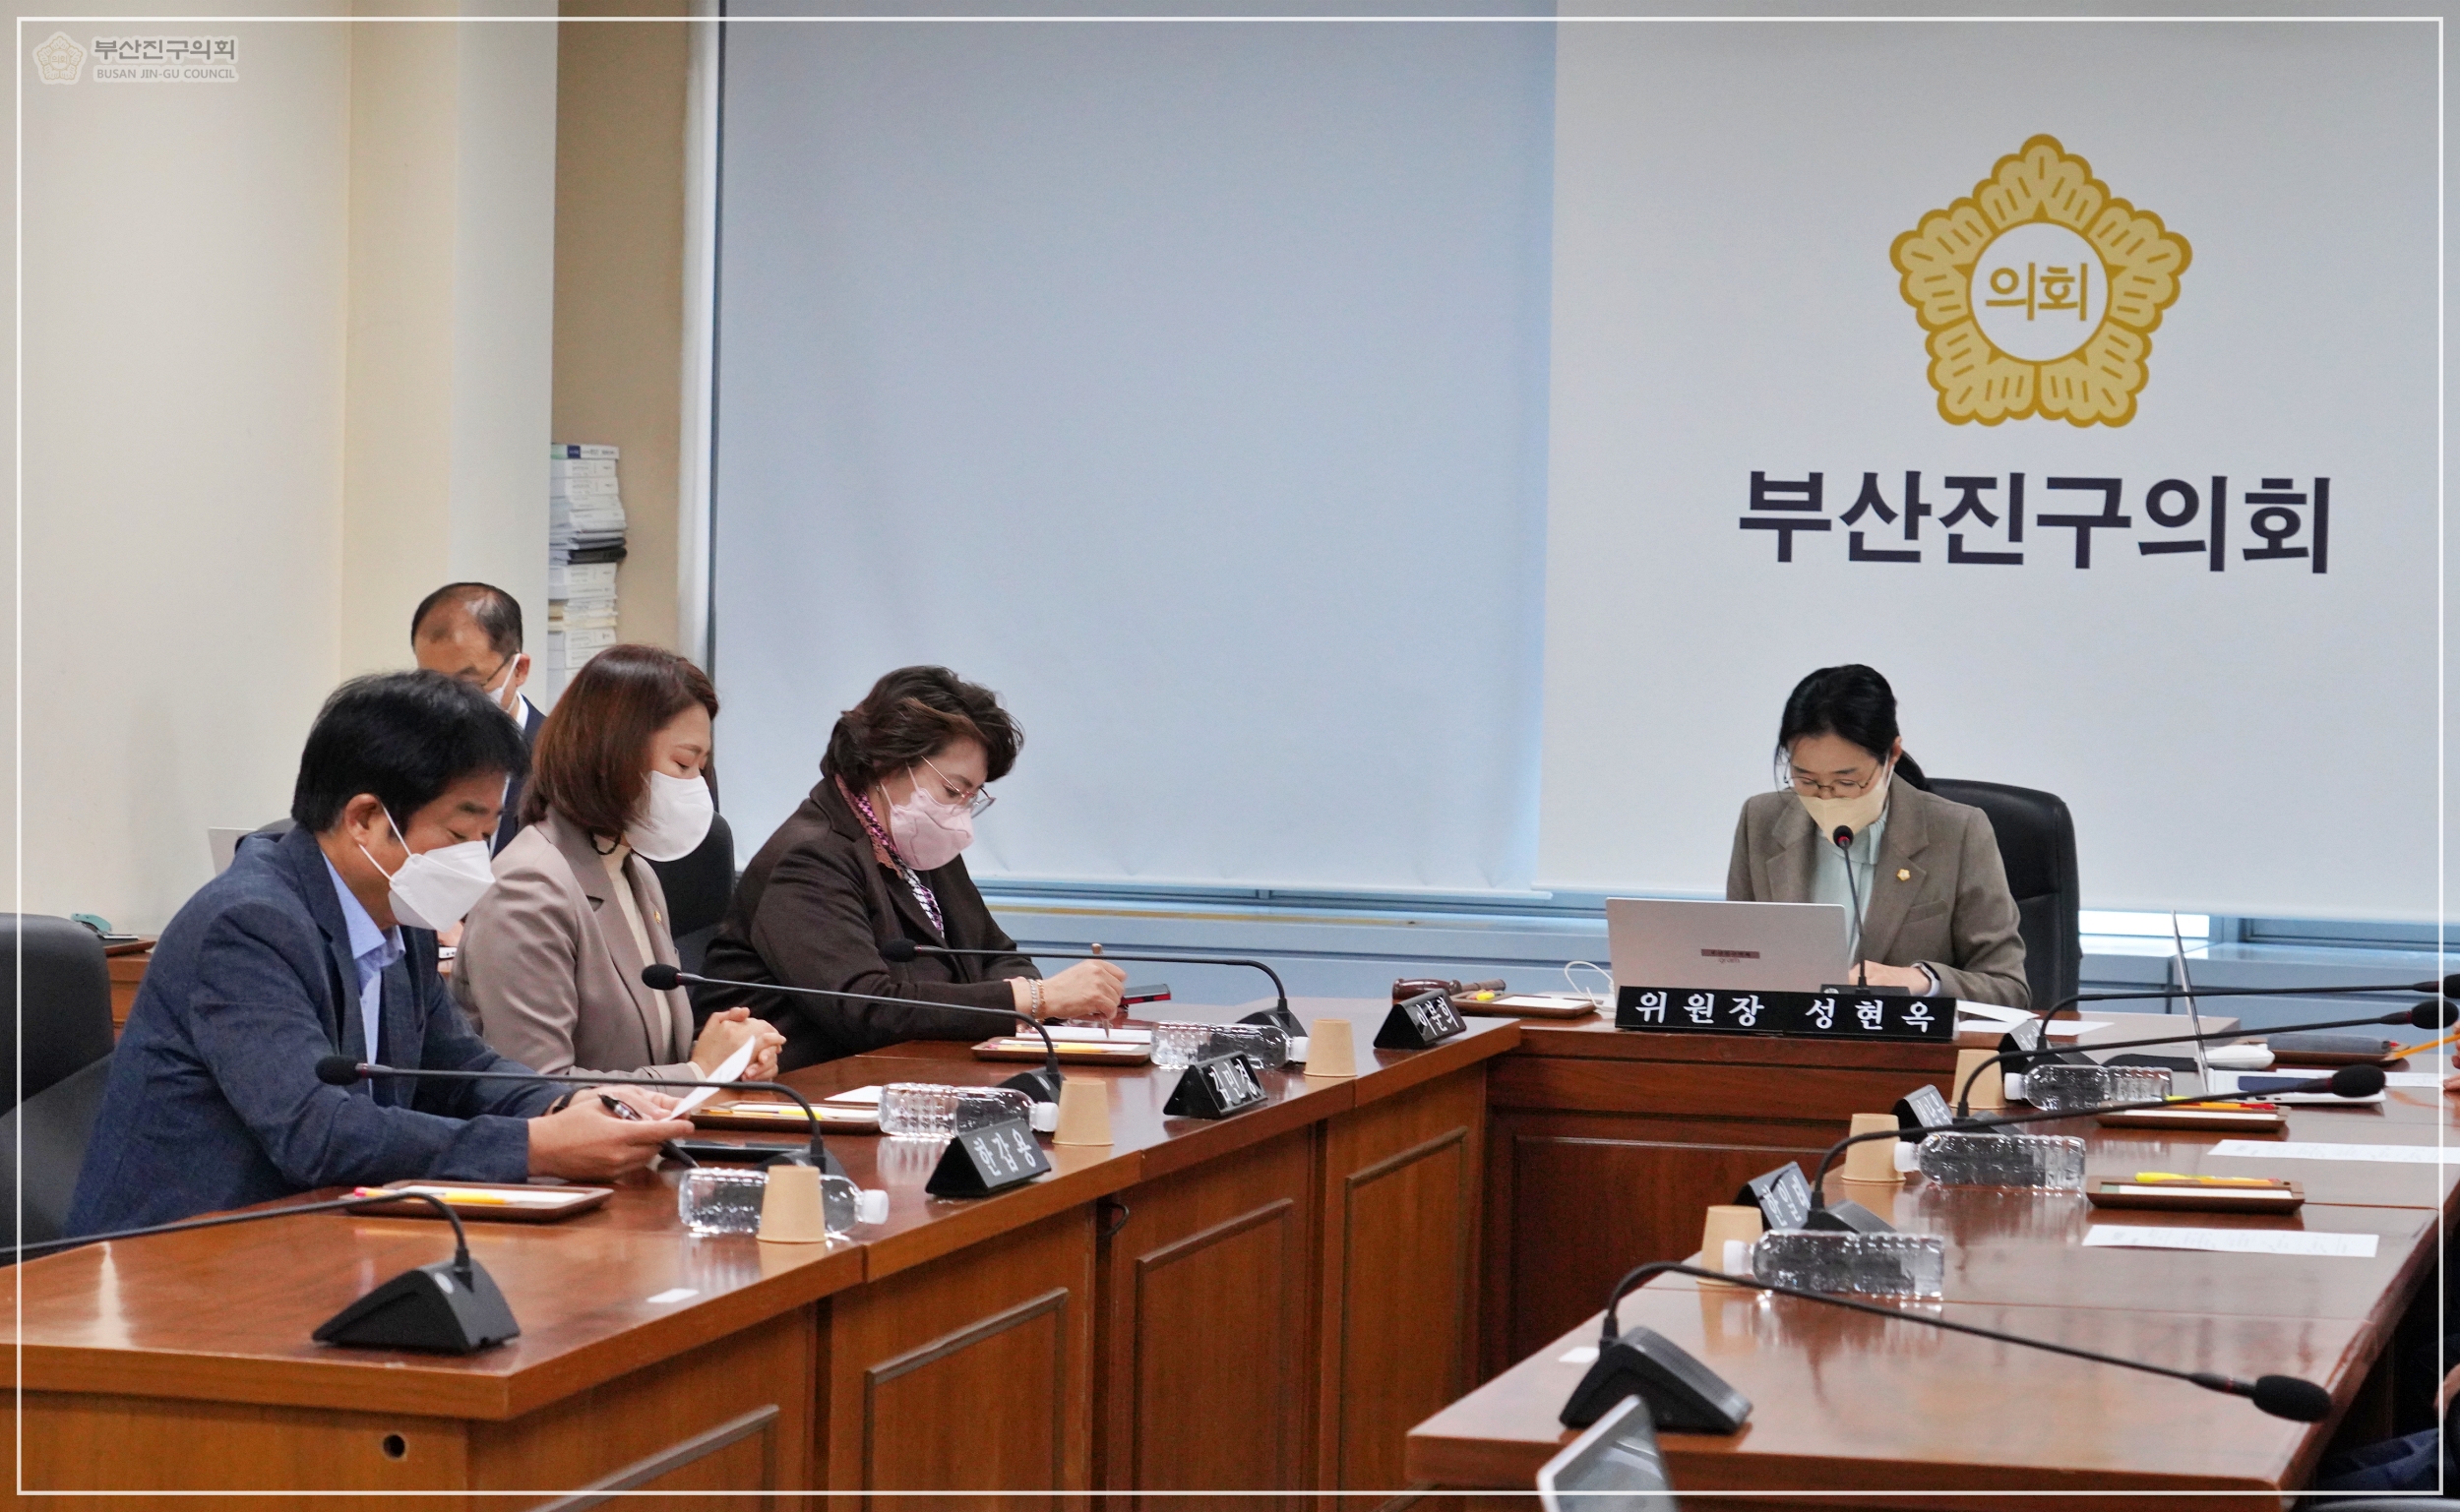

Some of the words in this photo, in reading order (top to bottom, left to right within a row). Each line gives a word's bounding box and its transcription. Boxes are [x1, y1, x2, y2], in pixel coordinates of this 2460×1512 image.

[1986, 262, 2088, 322] 의회
[1739, 470, 2330, 574] 부산진구의회
[1416, 996, 1460, 1037] 이분희
[1634, 992, 1765, 1027] 위원장
[1805, 998, 1936, 1033] 성현옥
[1208, 1058, 1258, 1104] 김민경
[972, 1127, 1037, 1178] 한갑용
